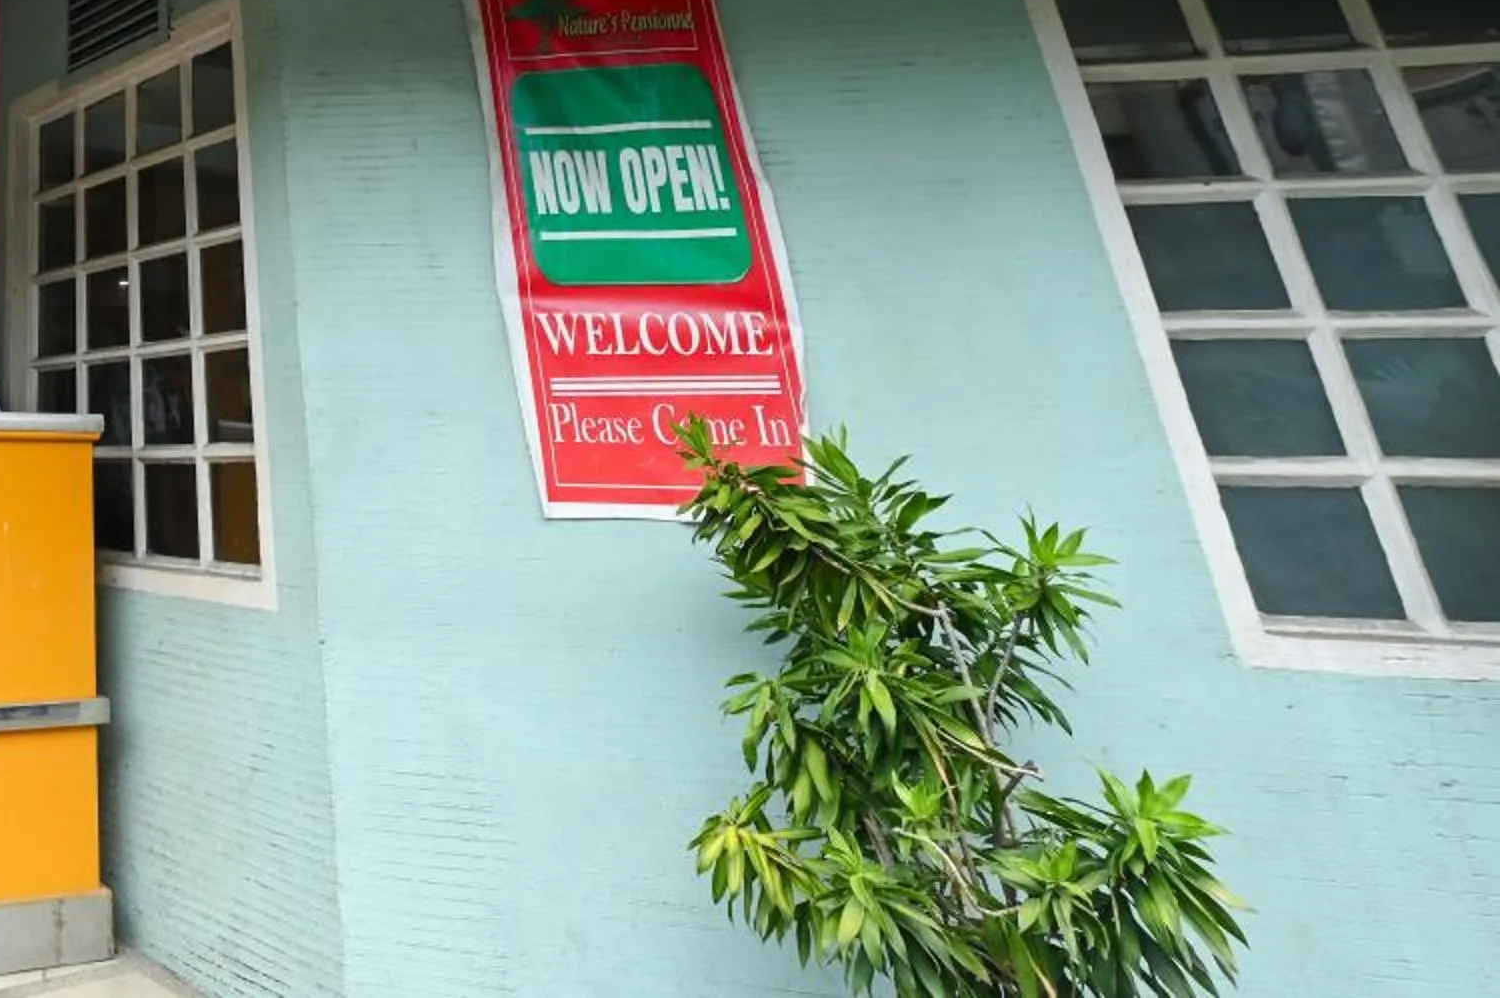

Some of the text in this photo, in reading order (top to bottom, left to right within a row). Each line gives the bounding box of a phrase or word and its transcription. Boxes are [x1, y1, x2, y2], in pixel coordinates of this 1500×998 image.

[557, 7, 694, 38] Nature's Pensionne
[529, 144, 731, 215] NOW OPEN!
[534, 311, 774, 357] WELCOME
[549, 402, 645, 445] Please
[752, 405, 793, 447] In
